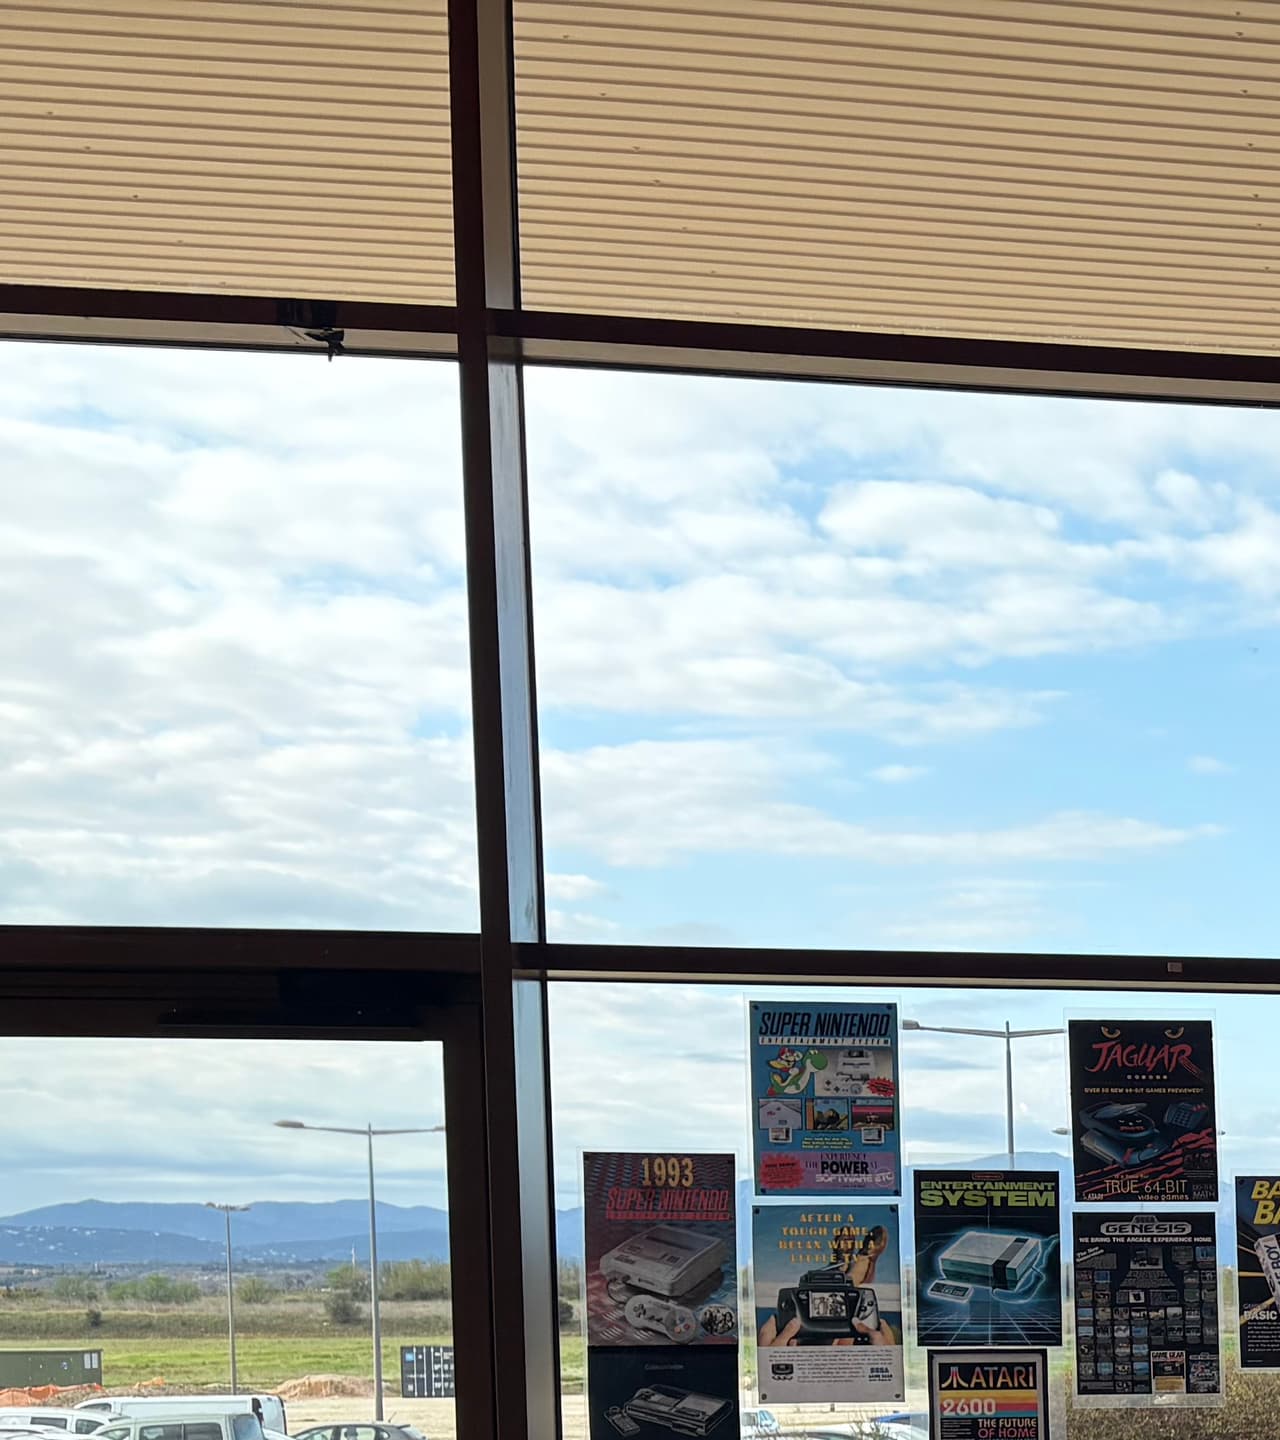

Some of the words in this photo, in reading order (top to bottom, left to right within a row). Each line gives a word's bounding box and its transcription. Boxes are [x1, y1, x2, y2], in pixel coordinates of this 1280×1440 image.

[759, 1012, 811, 1036] SUPER
[814, 1013, 892, 1038] NINTENDO
[760, 1037, 845, 1046] ENTERTAINMENT
[851, 1038, 891, 1047] SYSTEM
[1084, 1040, 1200, 1077] JAGUAR
[642, 1157, 694, 1188] 1993
[821, 1161, 869, 1175] POWER
[815, 1174, 873, 1184] SOFTWARE
[920, 1181, 1055, 1191] ENTERTAINMENT
[1104, 1179, 1140, 1193] TRUE
[1144, 1179, 1188, 1193] 64-BIT
[607, 1187, 655, 1211] SUPER
[658, 1189, 729, 1212] NINTENDO
[920, 1190, 1055, 1207] SYSTEM
[1192, 1191, 1215, 1199] MATH
[800, 1213, 841, 1222] AFTER
[848, 1213, 854, 1222] A
[782, 1227, 828, 1236] TOUGH
[1105, 1223, 1186, 1233] GENESIS
[779, 1240, 822, 1249] RELAX
[828, 1240, 864, 1249] WITH
[868, 1240, 875, 1249] A
[790, 1253, 836, 1263] LITTLE
[1243, 1311, 1278, 1320] BASIC
[969, 1366, 1035, 1389] ATARI
[943, 1398, 996, 1416] 2600
[978, 1418, 997, 1428] THE
[999, 1418, 1037, 1428] FUTURE
[978, 1428, 996, 1438] OF
[999, 1428, 1037, 1438] HOME
